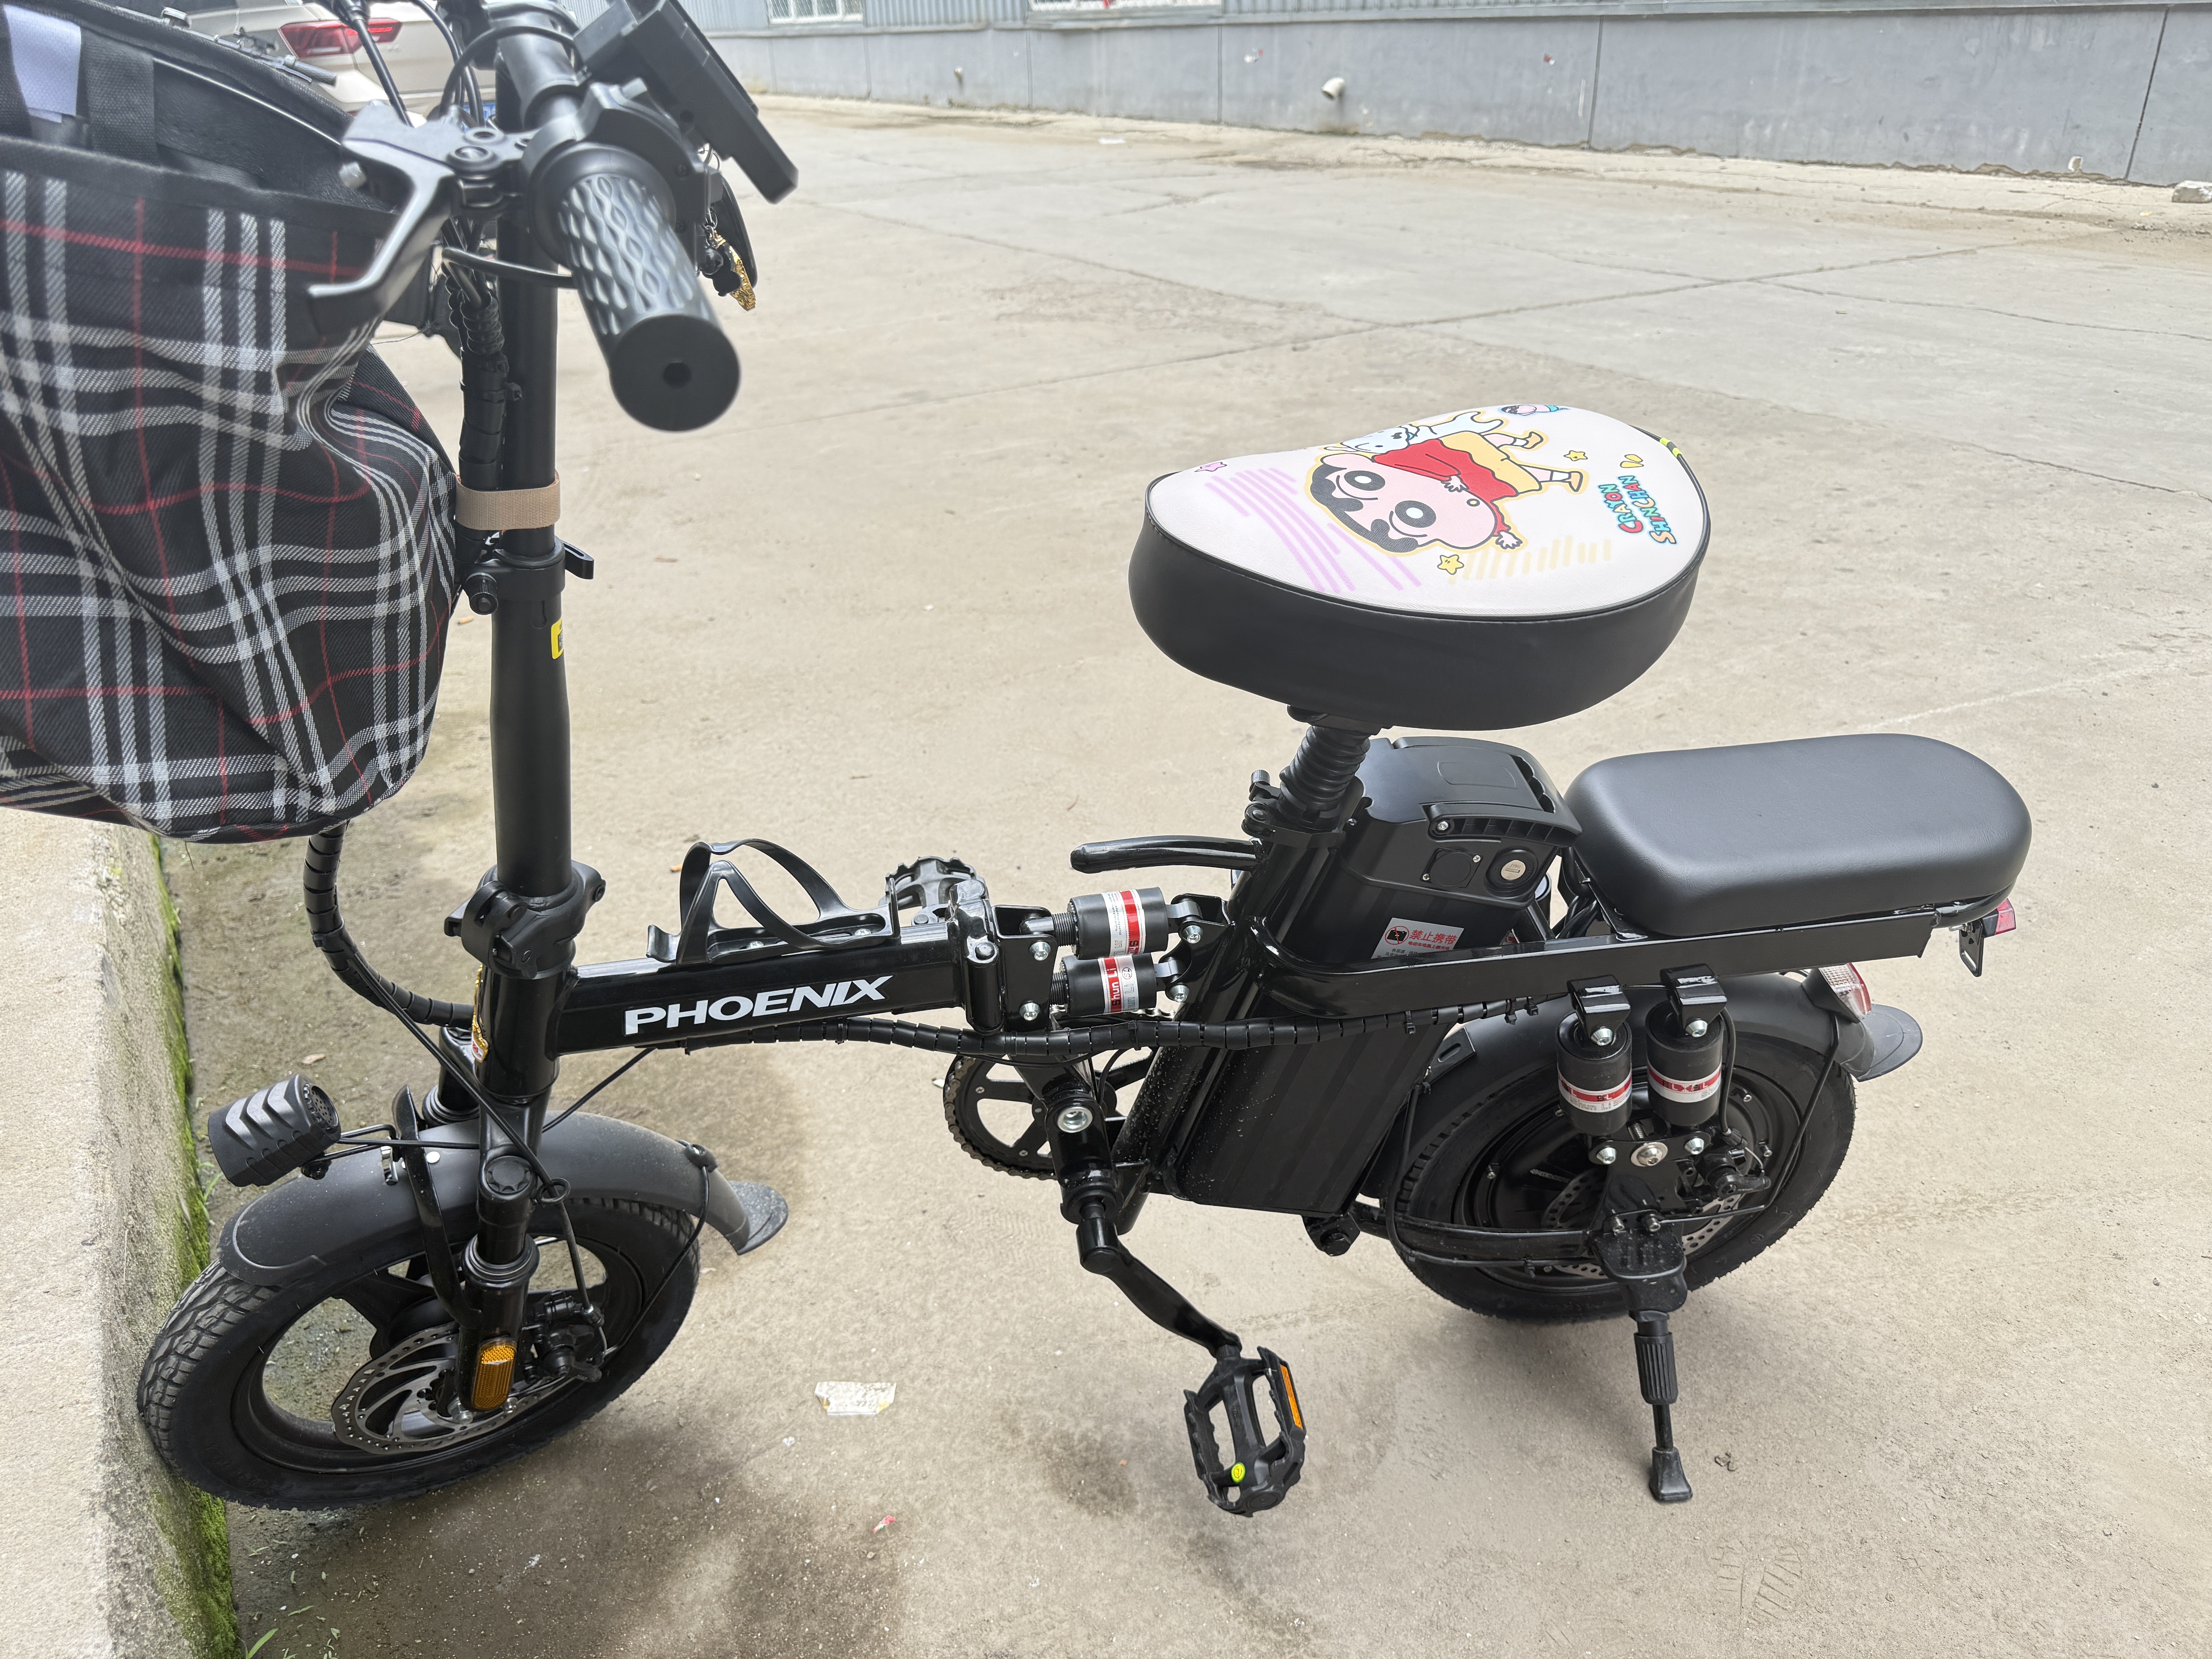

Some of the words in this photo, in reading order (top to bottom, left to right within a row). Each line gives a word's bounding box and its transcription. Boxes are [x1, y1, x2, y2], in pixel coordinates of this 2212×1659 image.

[1597, 484, 1644, 533] CRAYON
[1618, 475, 1677, 544] SHINCHAN
[1409, 929, 1457, 945] 禁止携带
[1128, 940, 1139, 955] Shu
[1107, 968, 1118, 978] Li
[1111, 981, 1121, 1006] Shun
[1124, 984, 1134, 994] Li
[625, 975, 893, 1035] PHOENIX
